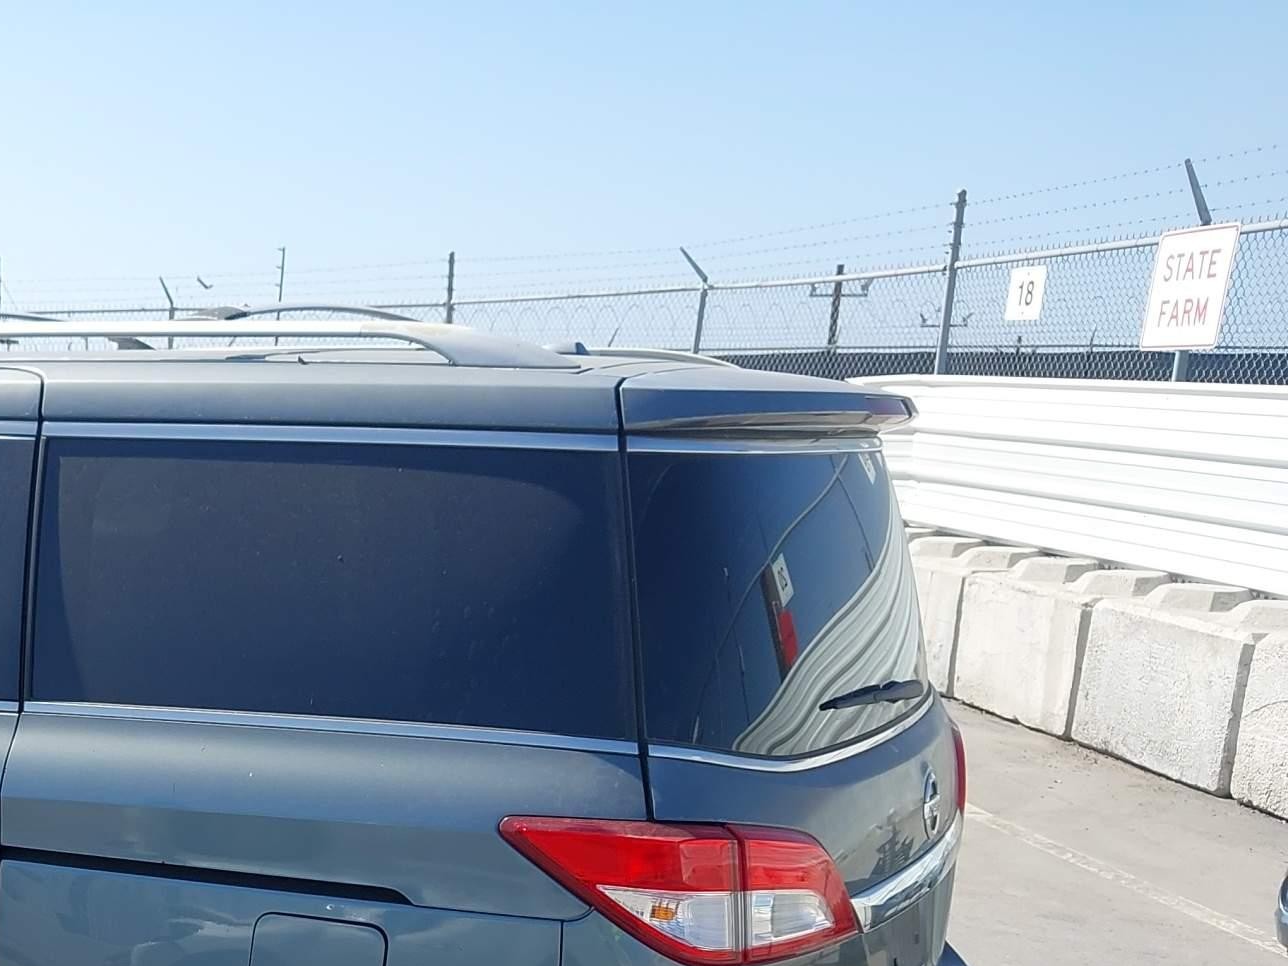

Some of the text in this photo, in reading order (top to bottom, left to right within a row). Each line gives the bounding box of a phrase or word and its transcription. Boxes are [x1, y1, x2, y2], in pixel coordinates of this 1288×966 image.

[1163, 249, 1222, 283] STATE
[1017, 280, 1035, 307] 18
[1157, 297, 1210, 329] FARM
